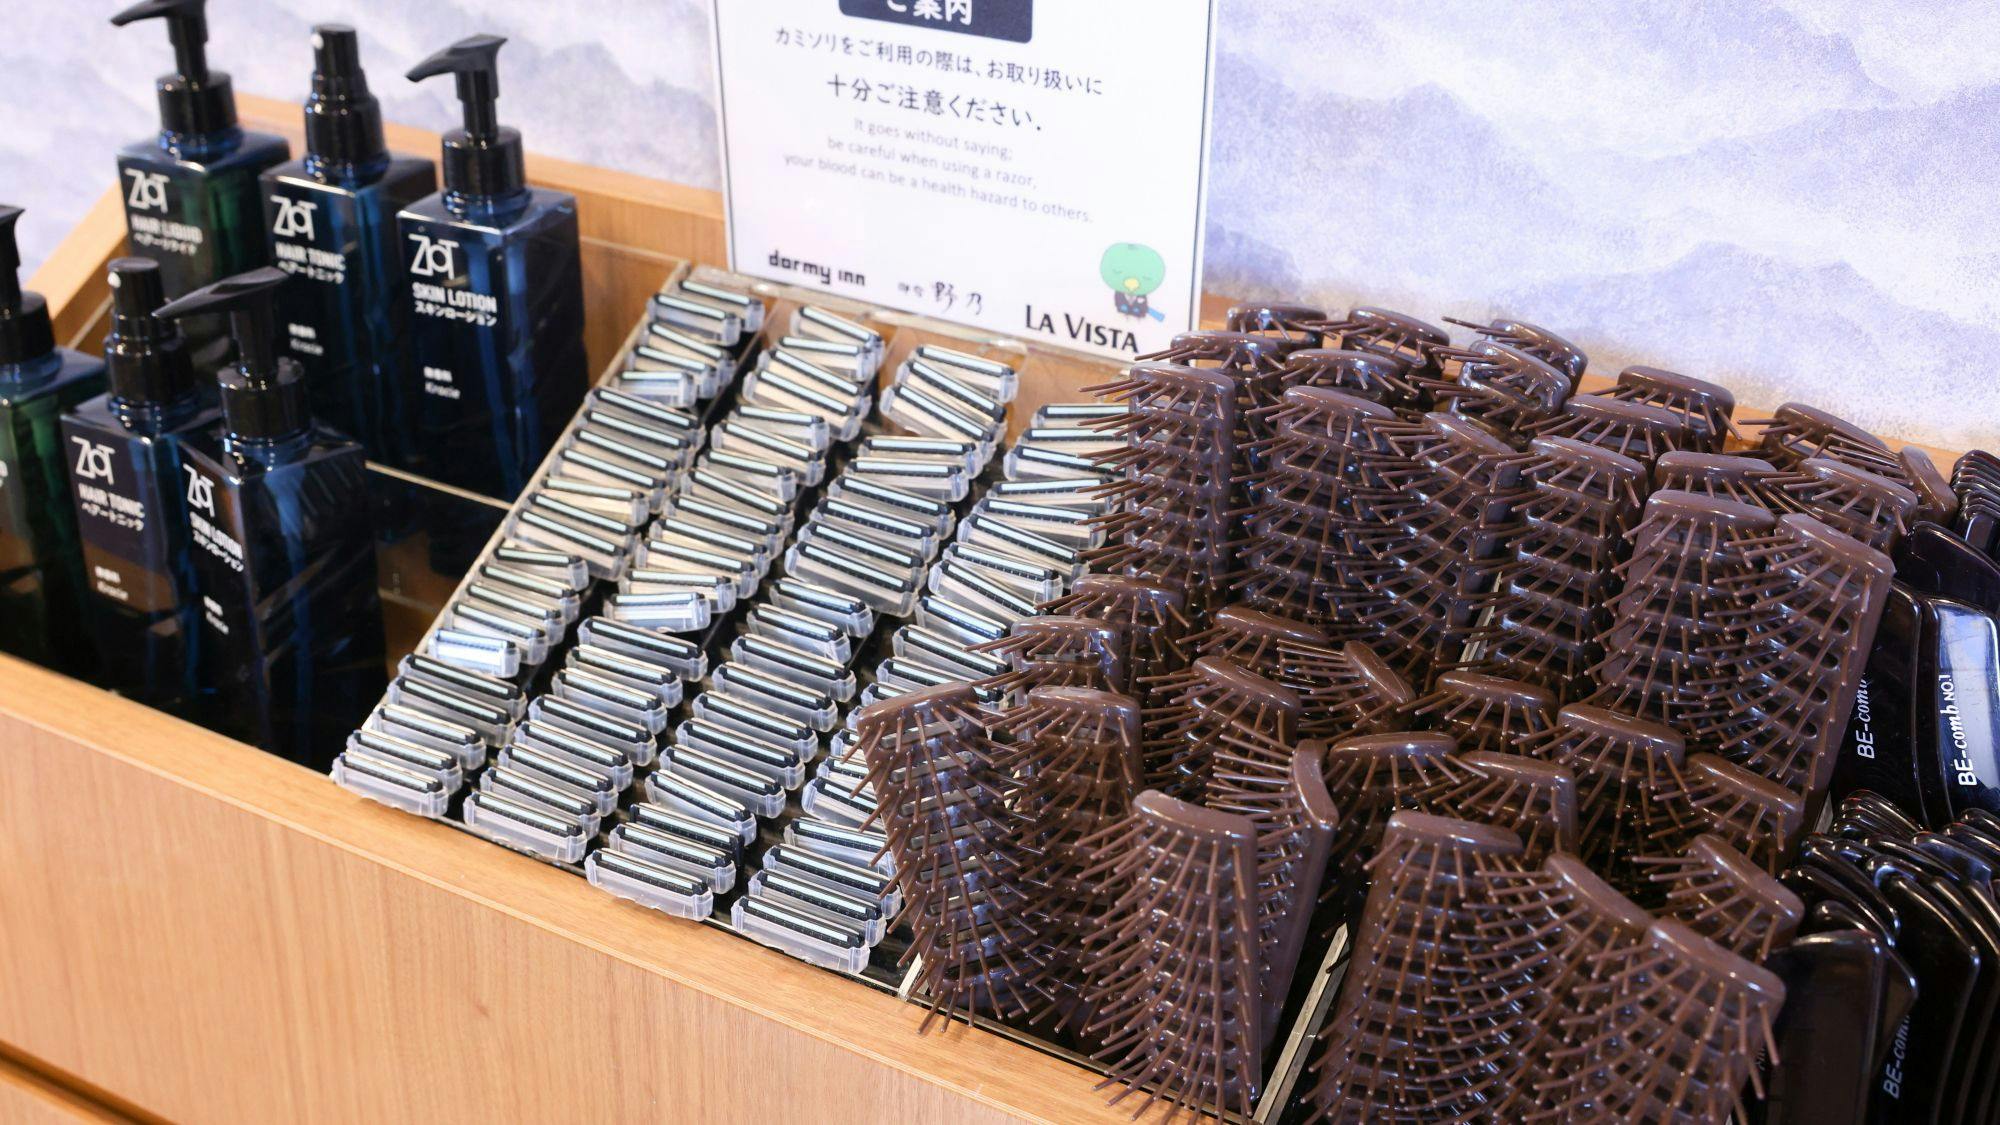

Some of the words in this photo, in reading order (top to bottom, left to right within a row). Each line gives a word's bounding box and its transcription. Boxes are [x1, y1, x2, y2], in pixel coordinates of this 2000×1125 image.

[775, 26, 1104, 95] カミソリをご利用の際は、お取り扱いに
[827, 136, 844, 150] be
[848, 143, 896, 160] careful
[900, 152, 938, 169] when
[942, 160, 979, 179] using
[868, 122, 900, 137] goes
[904, 128, 960, 149] without
[818, 158, 857, 176] blood
[861, 168, 885, 181] can
[889, 171, 906, 186] be
[921, 178, 966, 198] health
[970, 185, 1018, 208] hazard
[1022, 198, 1038, 212] to
[769, 249, 831, 285] dormy
[838, 268, 866, 287] inn
[412, 282, 446, 304] SKIN
[447, 288, 498, 314] LOTION
[1026, 304, 1056, 335] LA
[1065, 313, 1139, 354] VISTA
[1940, 704, 1978, 786] BE-comb
